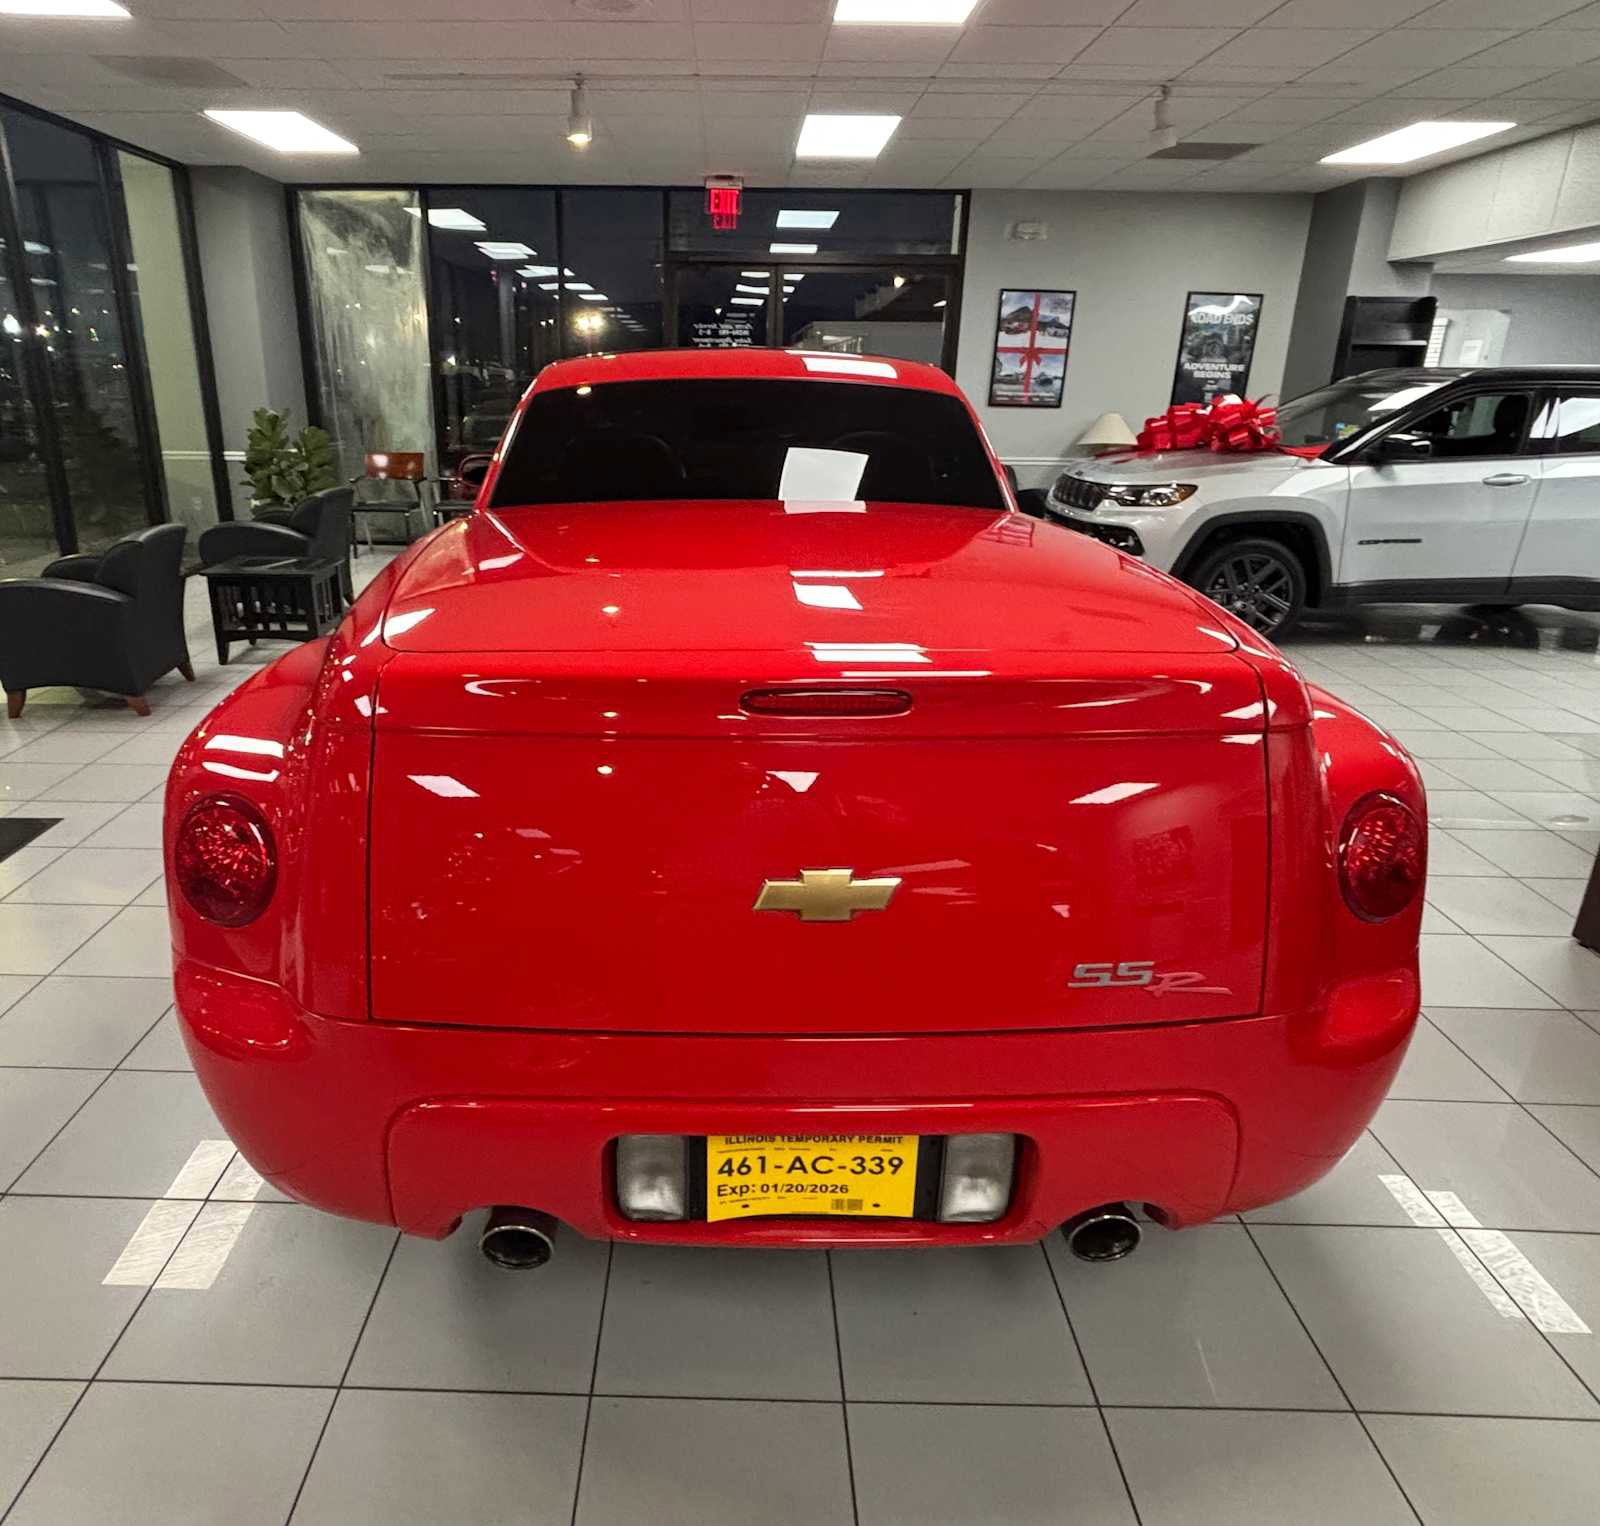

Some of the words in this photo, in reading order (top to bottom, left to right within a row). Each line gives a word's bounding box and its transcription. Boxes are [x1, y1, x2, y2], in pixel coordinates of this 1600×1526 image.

[1183, 362, 1245, 371] ADVENTURE
[1193, 371, 1231, 379] BEGINS
[725, 1136, 775, 1145] ILLINOIS
[780, 1136, 854, 1144] TEMPORARY
[858, 1136, 904, 1144] PERMIT
[717, 1155, 904, 1177] 461-AC-339
[717, 1184, 756, 1198] Exp:
[760, 1183, 849, 1194] 01/20/2026
